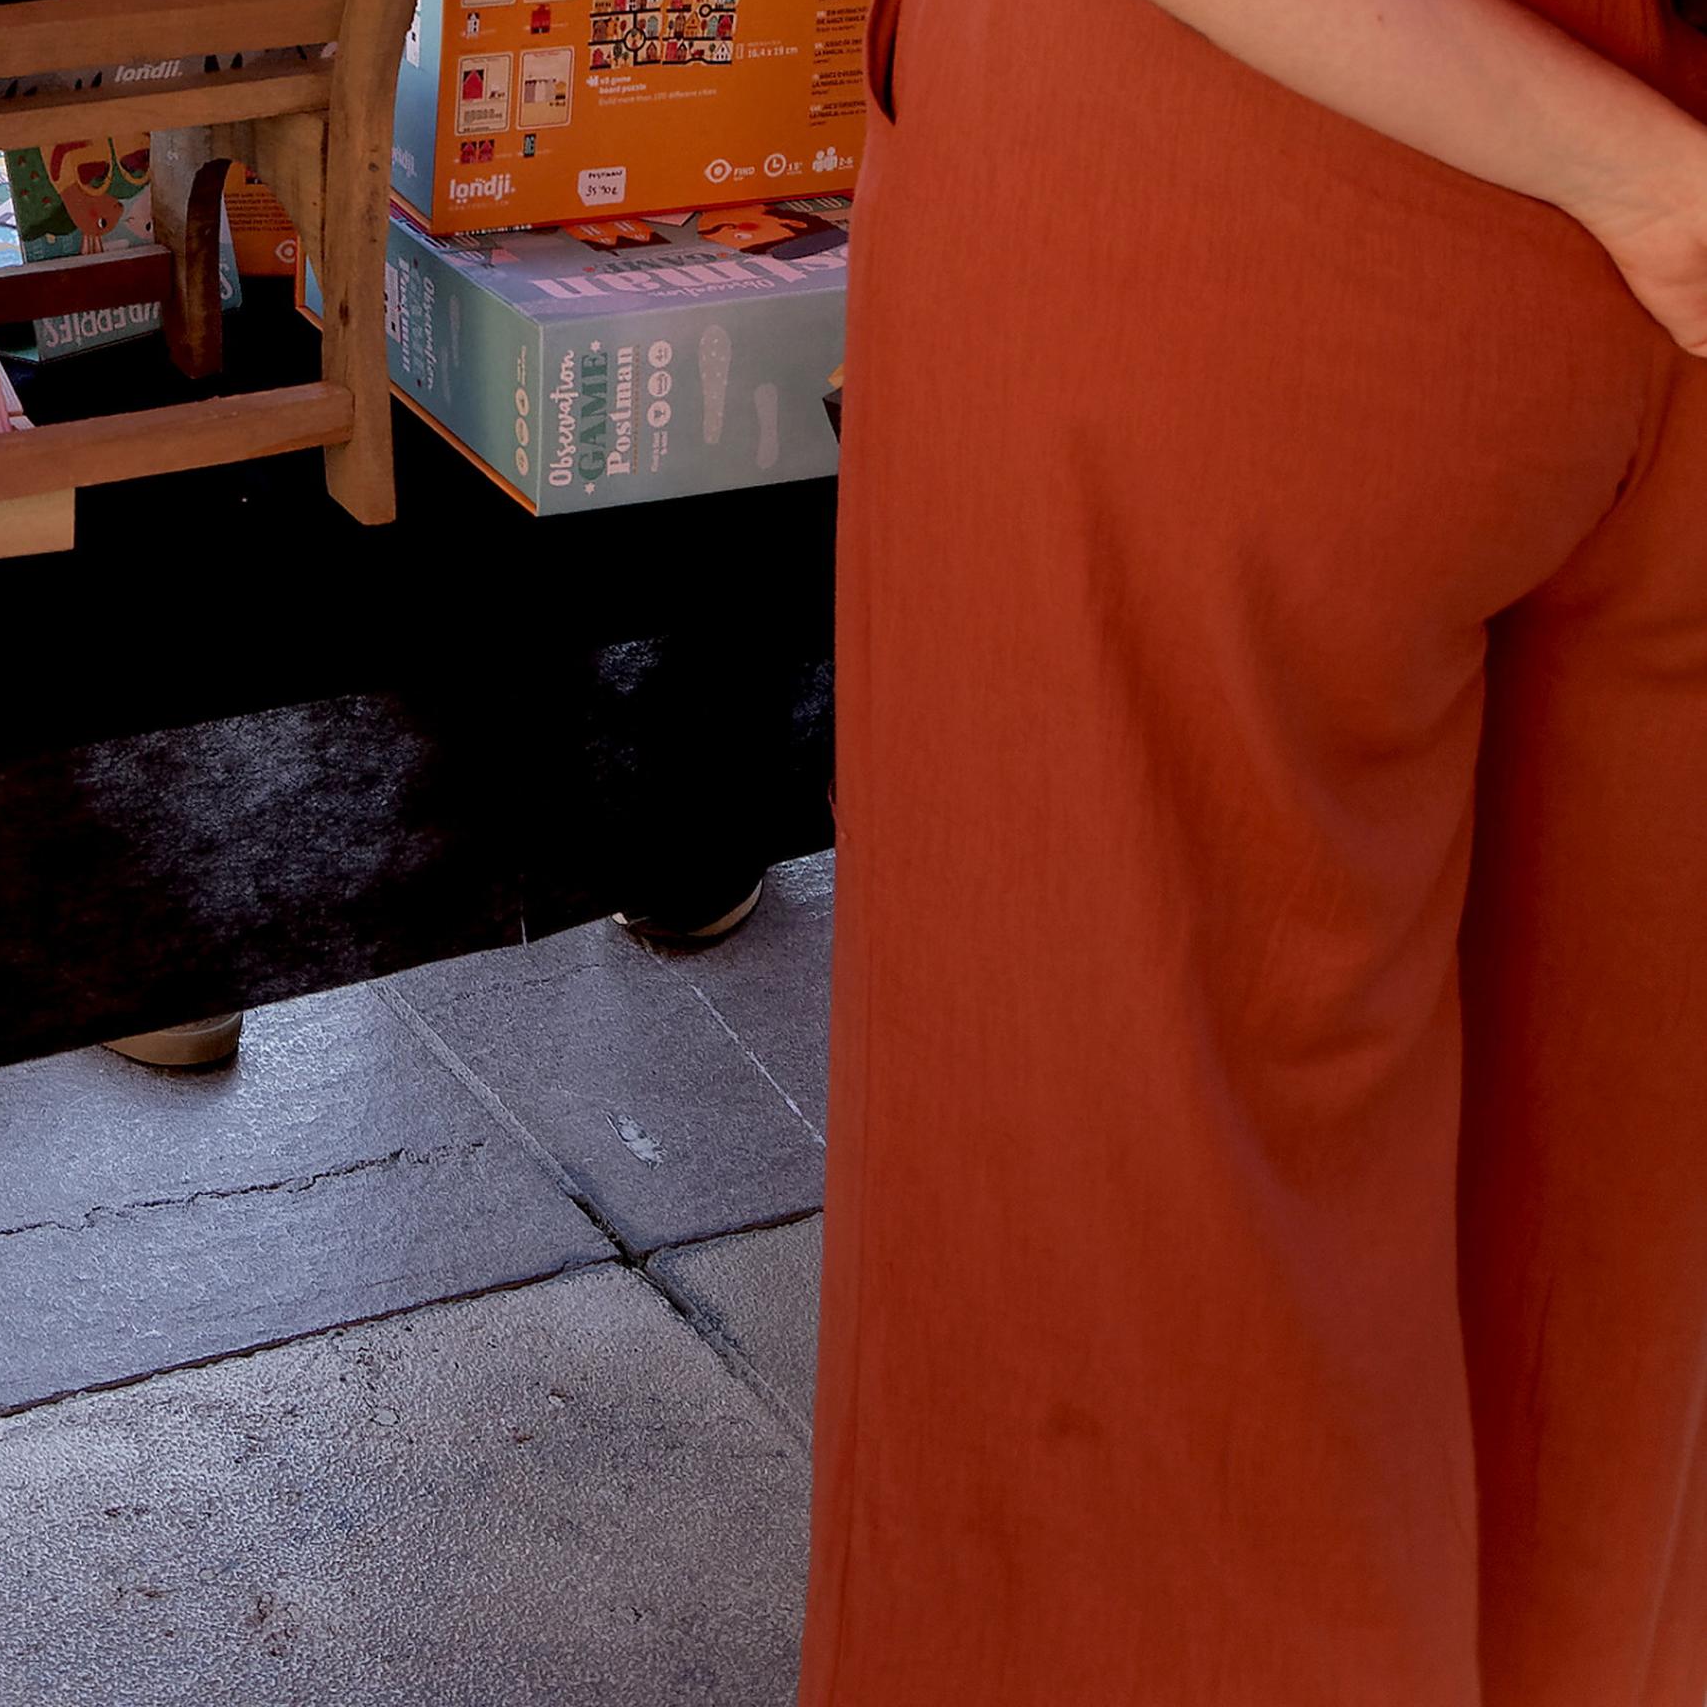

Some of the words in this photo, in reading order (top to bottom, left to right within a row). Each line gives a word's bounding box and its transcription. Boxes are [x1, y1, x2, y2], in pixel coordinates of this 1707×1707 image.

[548, 349, 579, 486] Observation
[578, 351, 608, 481] GAME
[606, 346, 634, 477] Postman
